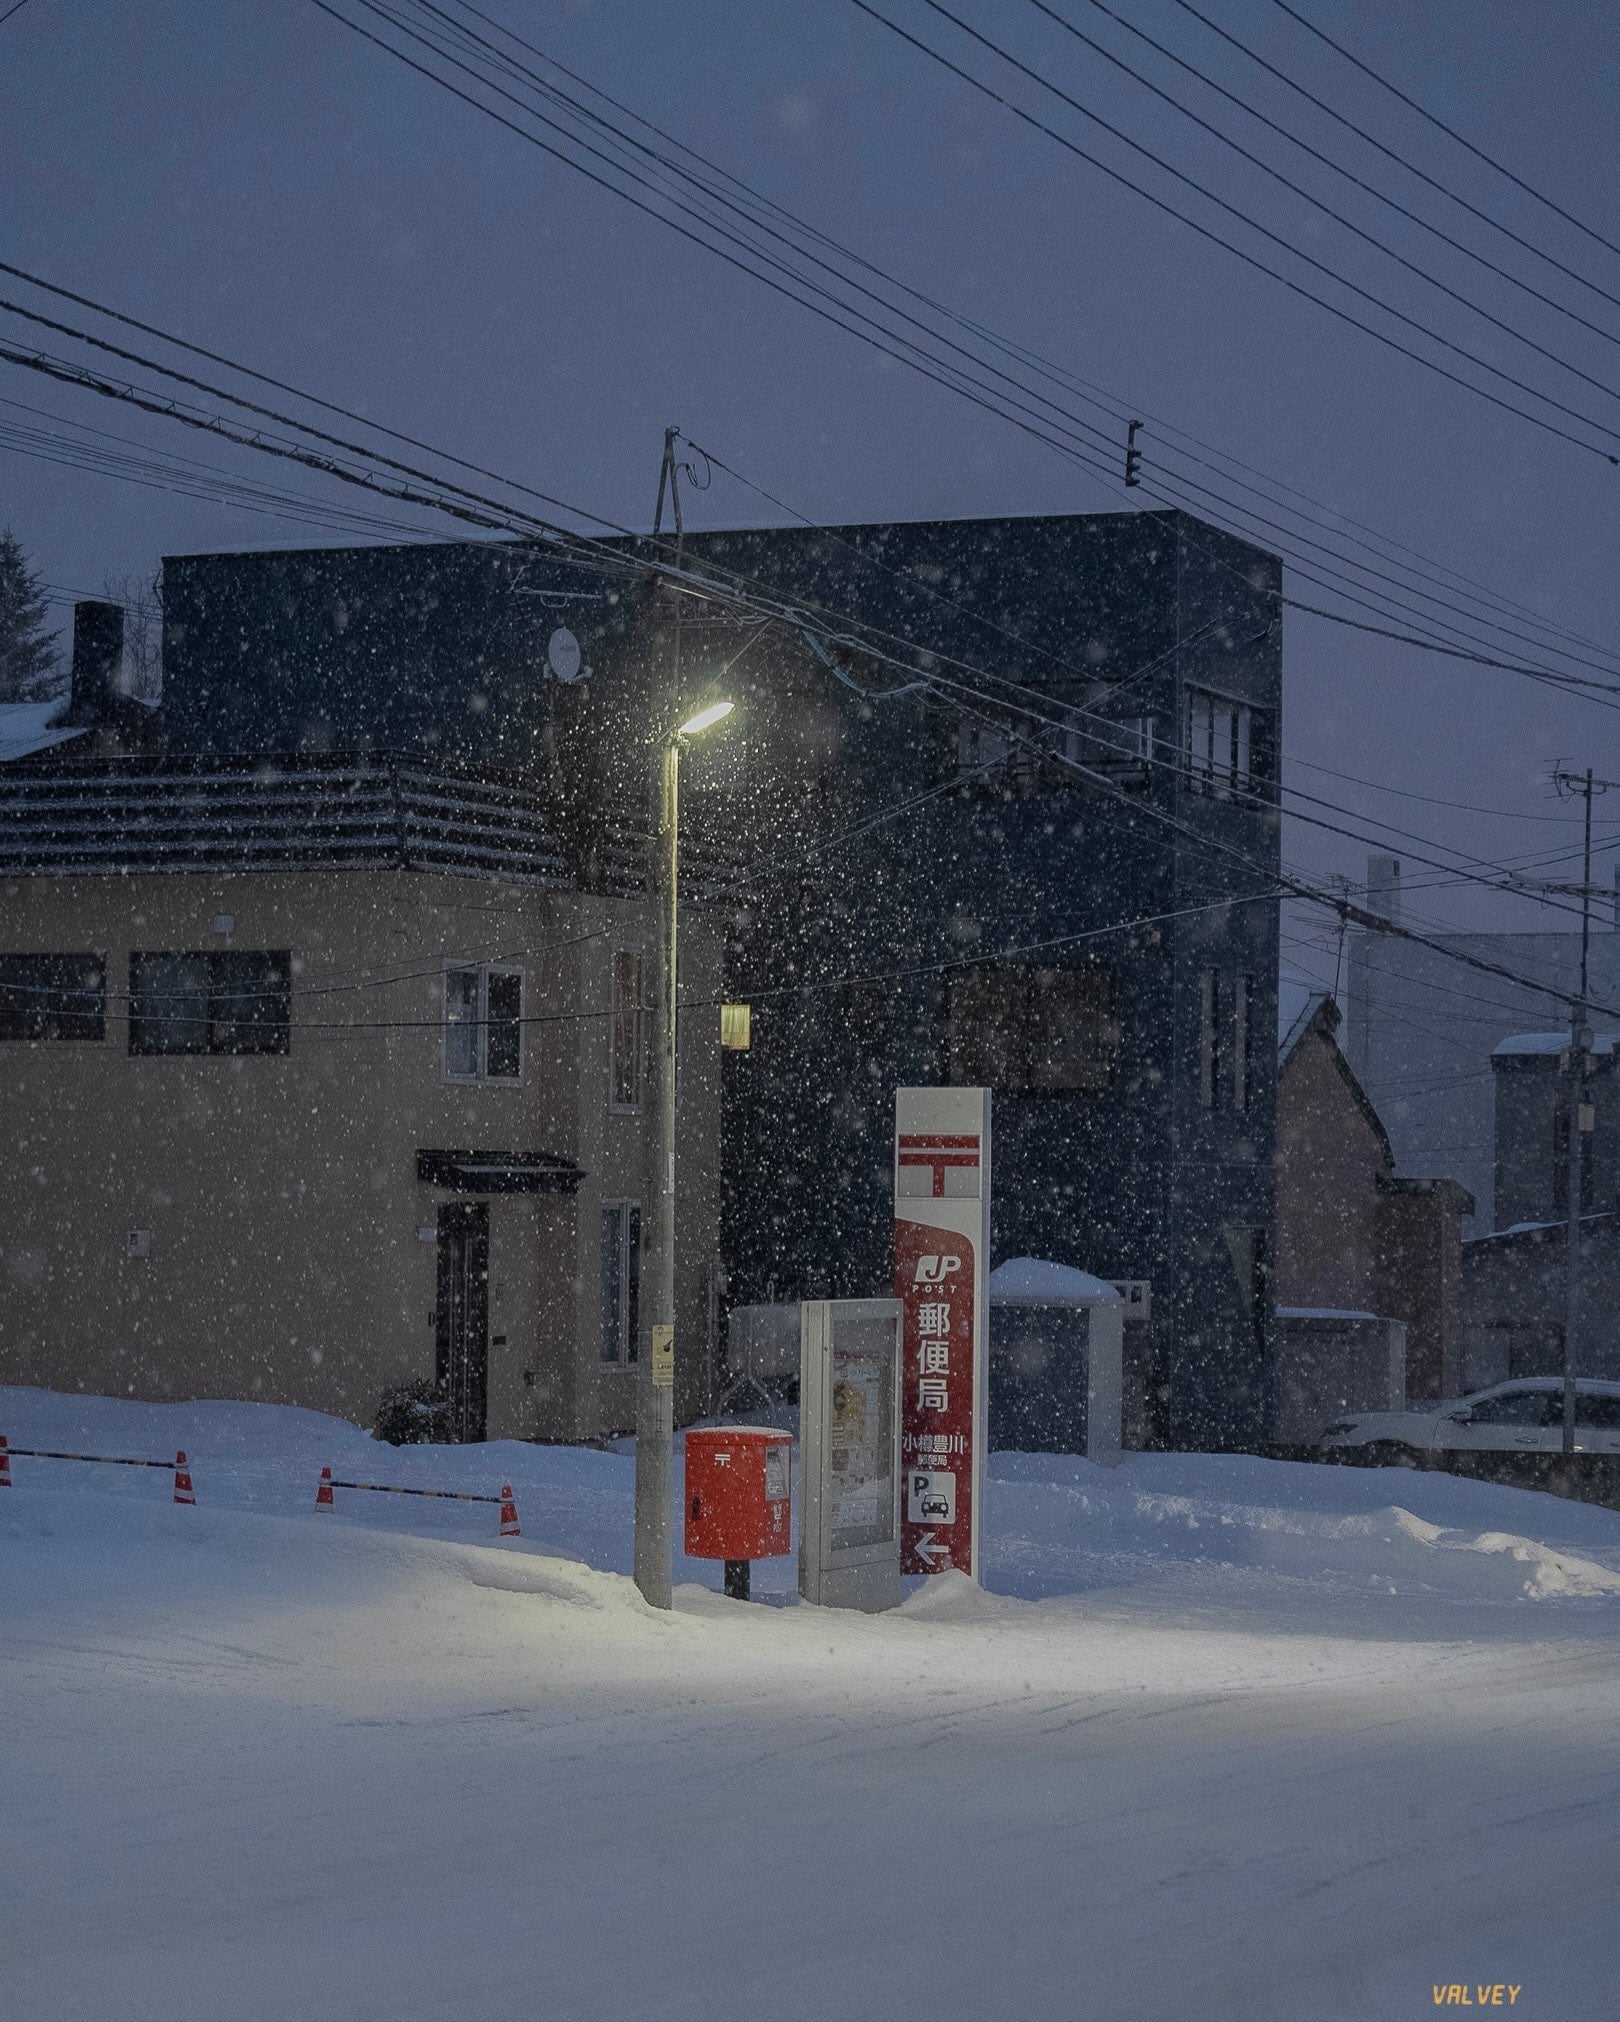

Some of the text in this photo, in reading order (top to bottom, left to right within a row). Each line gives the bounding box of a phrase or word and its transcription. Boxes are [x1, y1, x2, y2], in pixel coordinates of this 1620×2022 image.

[914, 1255, 962, 1283] JP
[912, 1284, 957, 1294] POST
[916, 1302, 951, 1413] 郵便局
[902, 1433, 964, 1455] 小樽豊川
[917, 1453, 948, 1466] 郵便局
[914, 1476, 929, 1497] P
